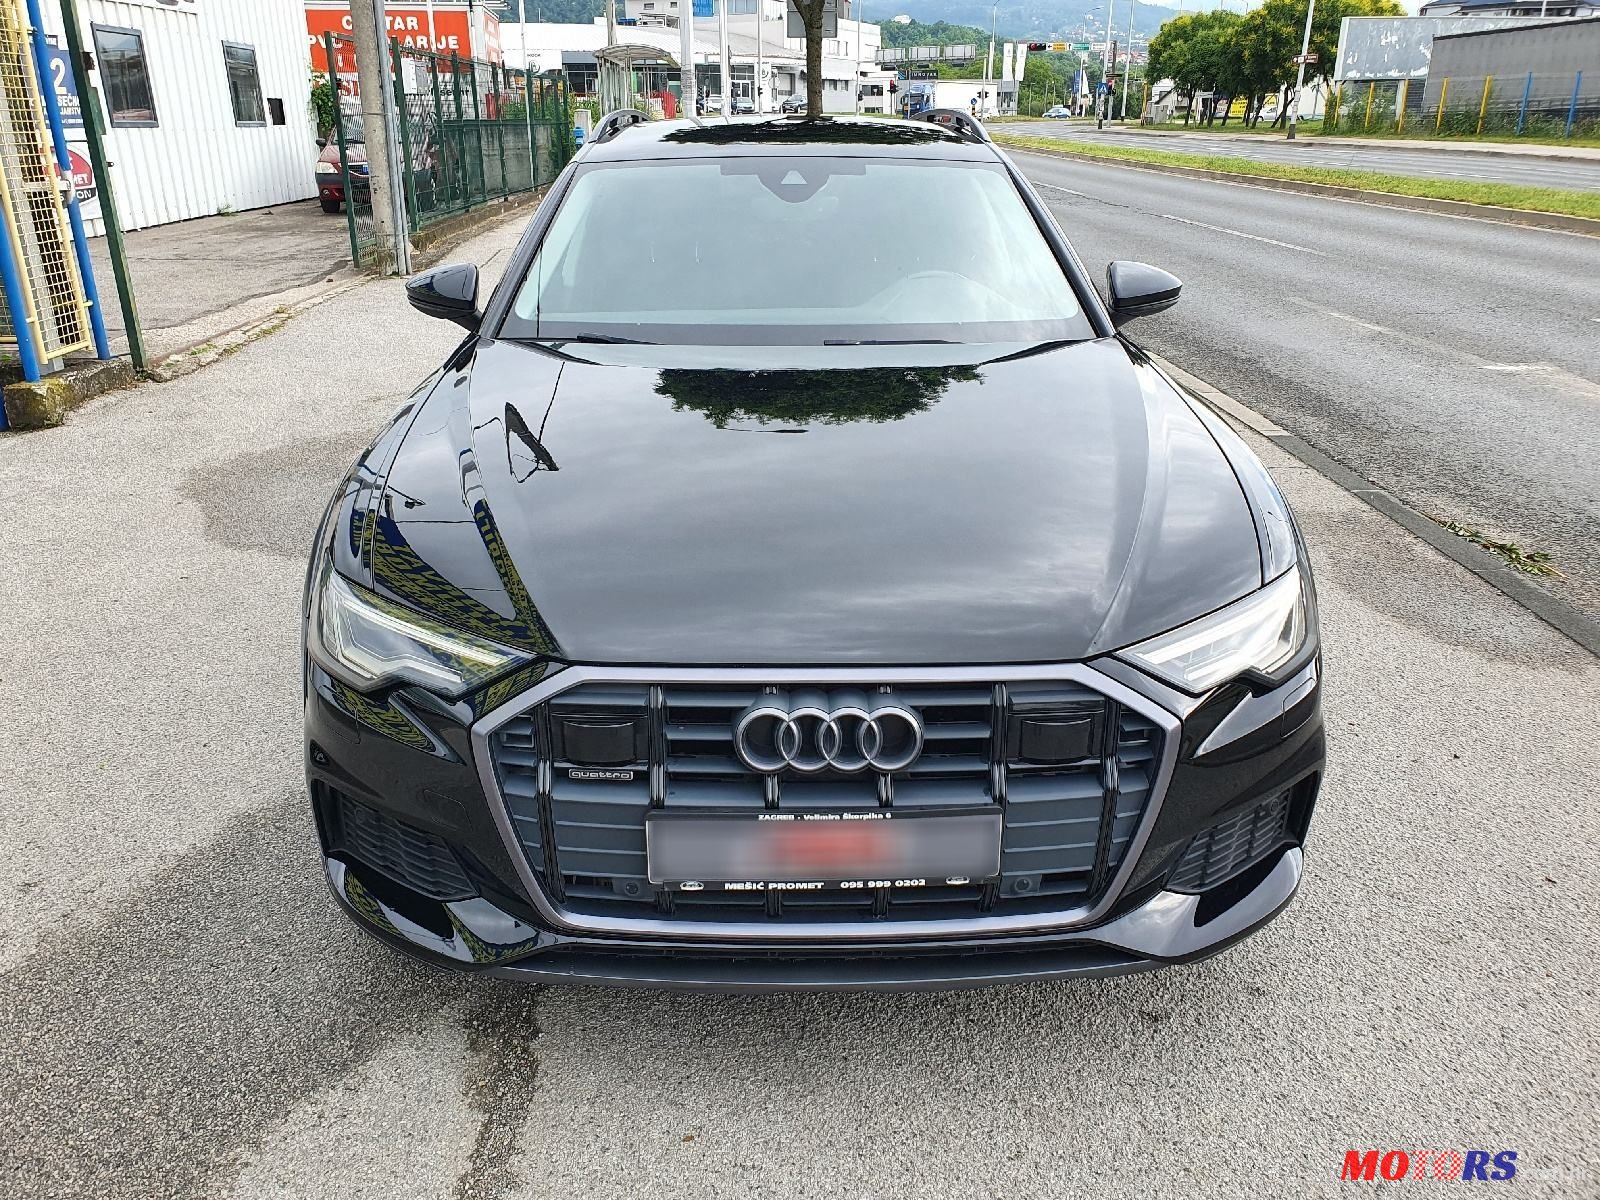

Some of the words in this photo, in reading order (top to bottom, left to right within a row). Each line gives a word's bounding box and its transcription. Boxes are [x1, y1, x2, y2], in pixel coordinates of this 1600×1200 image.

[571, 771, 630, 779] quattro
[724, 881, 765, 890] MEŠIĆ
[768, 882, 825, 890] PROMET
[840, 881, 864, 889] 095
